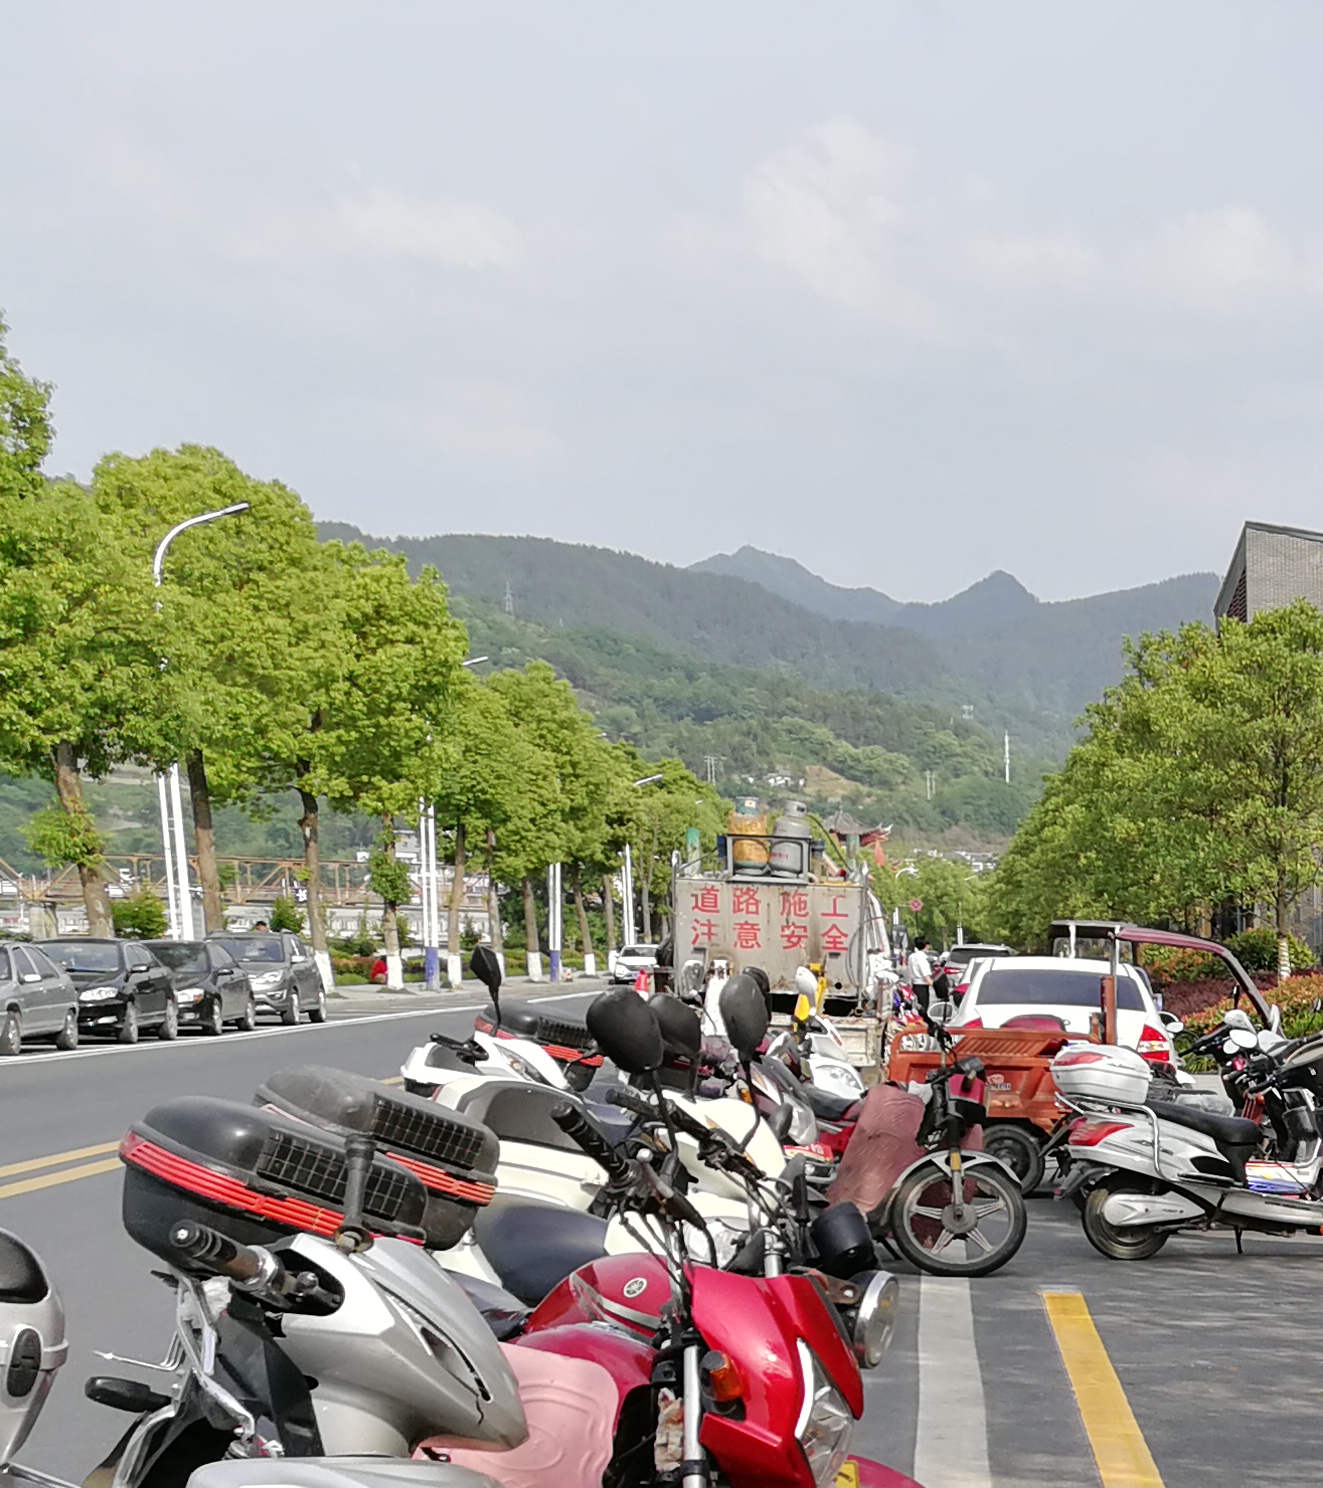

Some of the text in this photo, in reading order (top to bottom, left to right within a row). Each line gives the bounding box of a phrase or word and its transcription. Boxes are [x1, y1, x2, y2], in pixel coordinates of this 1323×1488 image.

[691, 885, 848, 919] 道路施工
[691, 918, 849, 953] 注意安全
